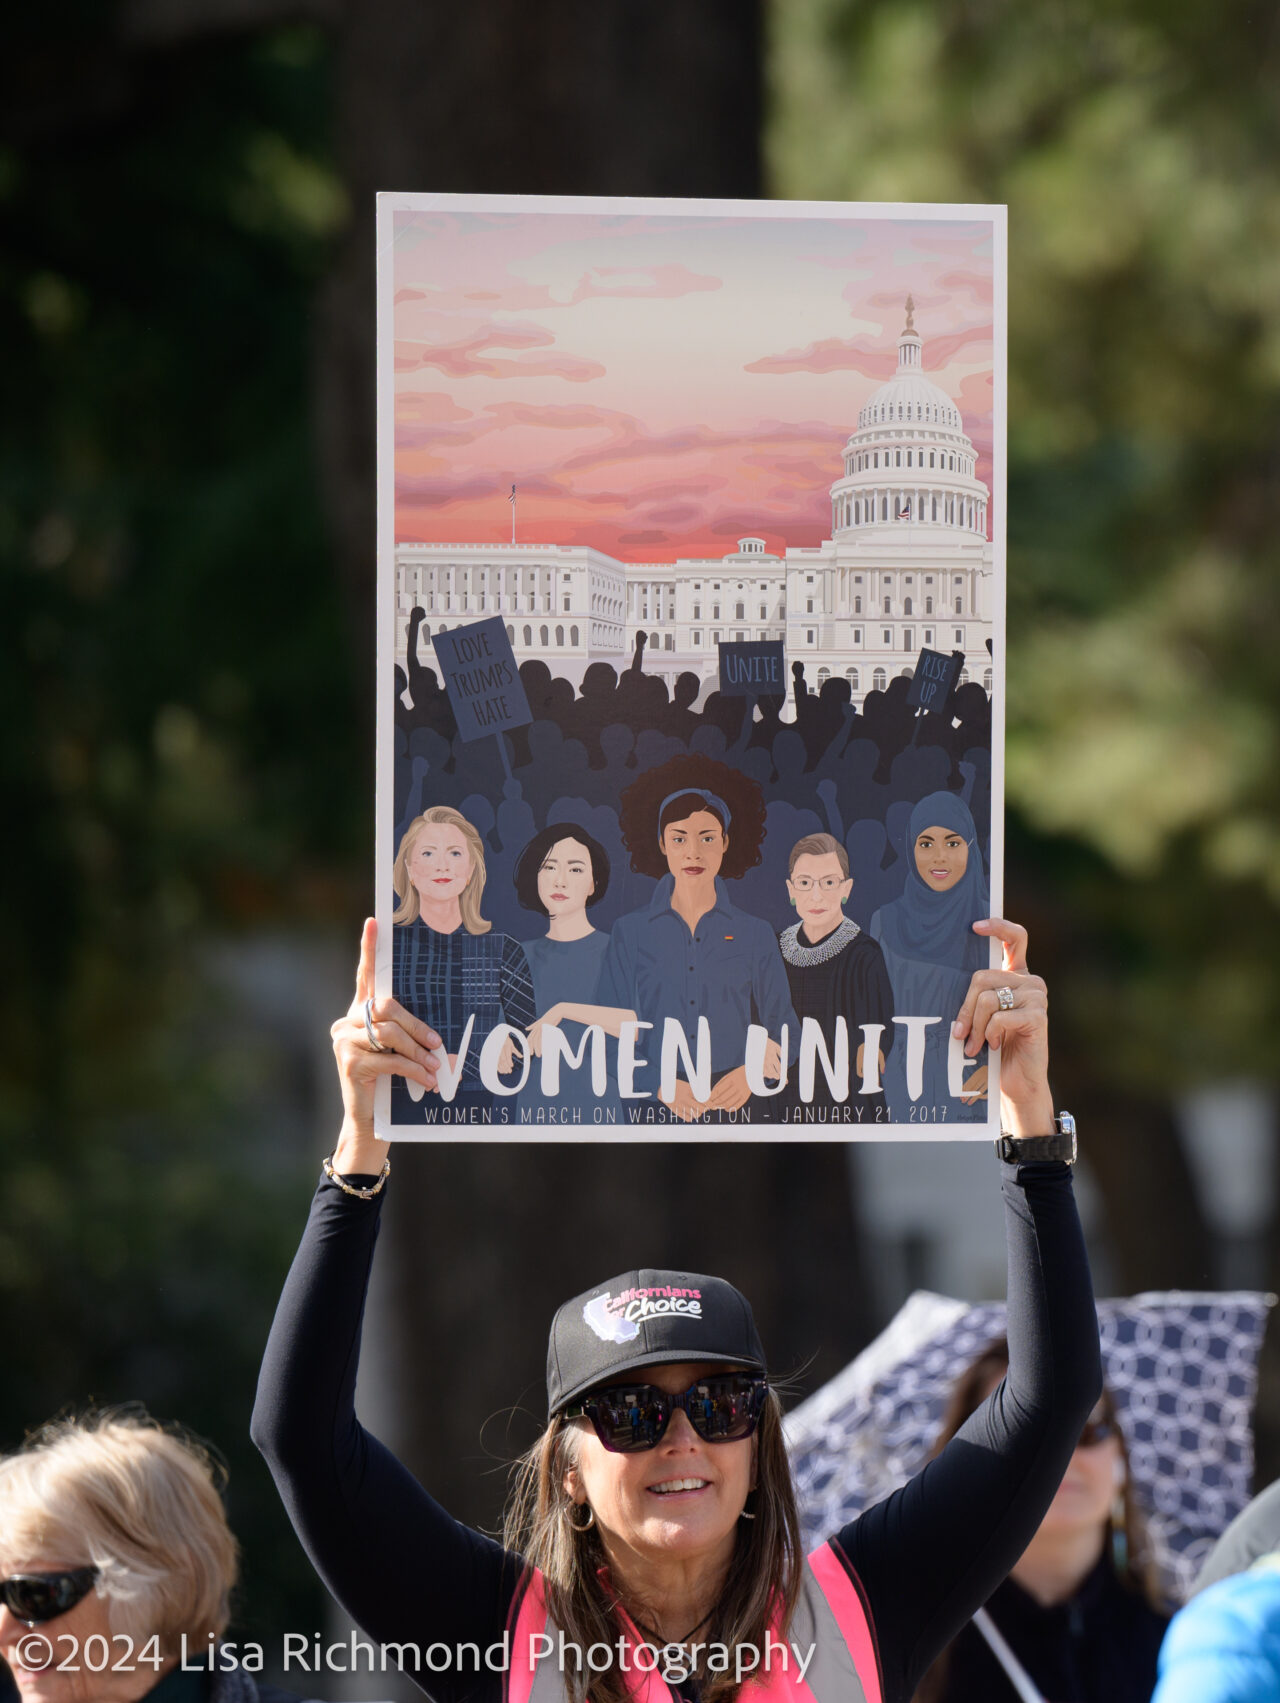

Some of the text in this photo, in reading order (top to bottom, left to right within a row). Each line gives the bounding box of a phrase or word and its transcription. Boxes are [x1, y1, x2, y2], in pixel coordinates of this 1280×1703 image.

[451, 632, 493, 665] LOVE
[450, 660, 513, 699] TRUMPS
[726, 654, 778, 684] UNITE
[921, 655, 950, 682] RISE
[920, 681, 937, 704] UP
[472, 695, 512, 726] HATE
[405, 1013, 982, 1104] WOMEN UNITE
[424, 1106, 510, 1125] WOMEN'S
[520, 1106, 582, 1125] MARCH
[593, 1106, 617, 1125] ON
[628, 1105, 751, 1124] WASHINGTON
[781, 1105, 865, 1124] JANUARY
[909, 1104, 949, 1124] 2017
[624, 1296, 703, 1322] Choice
